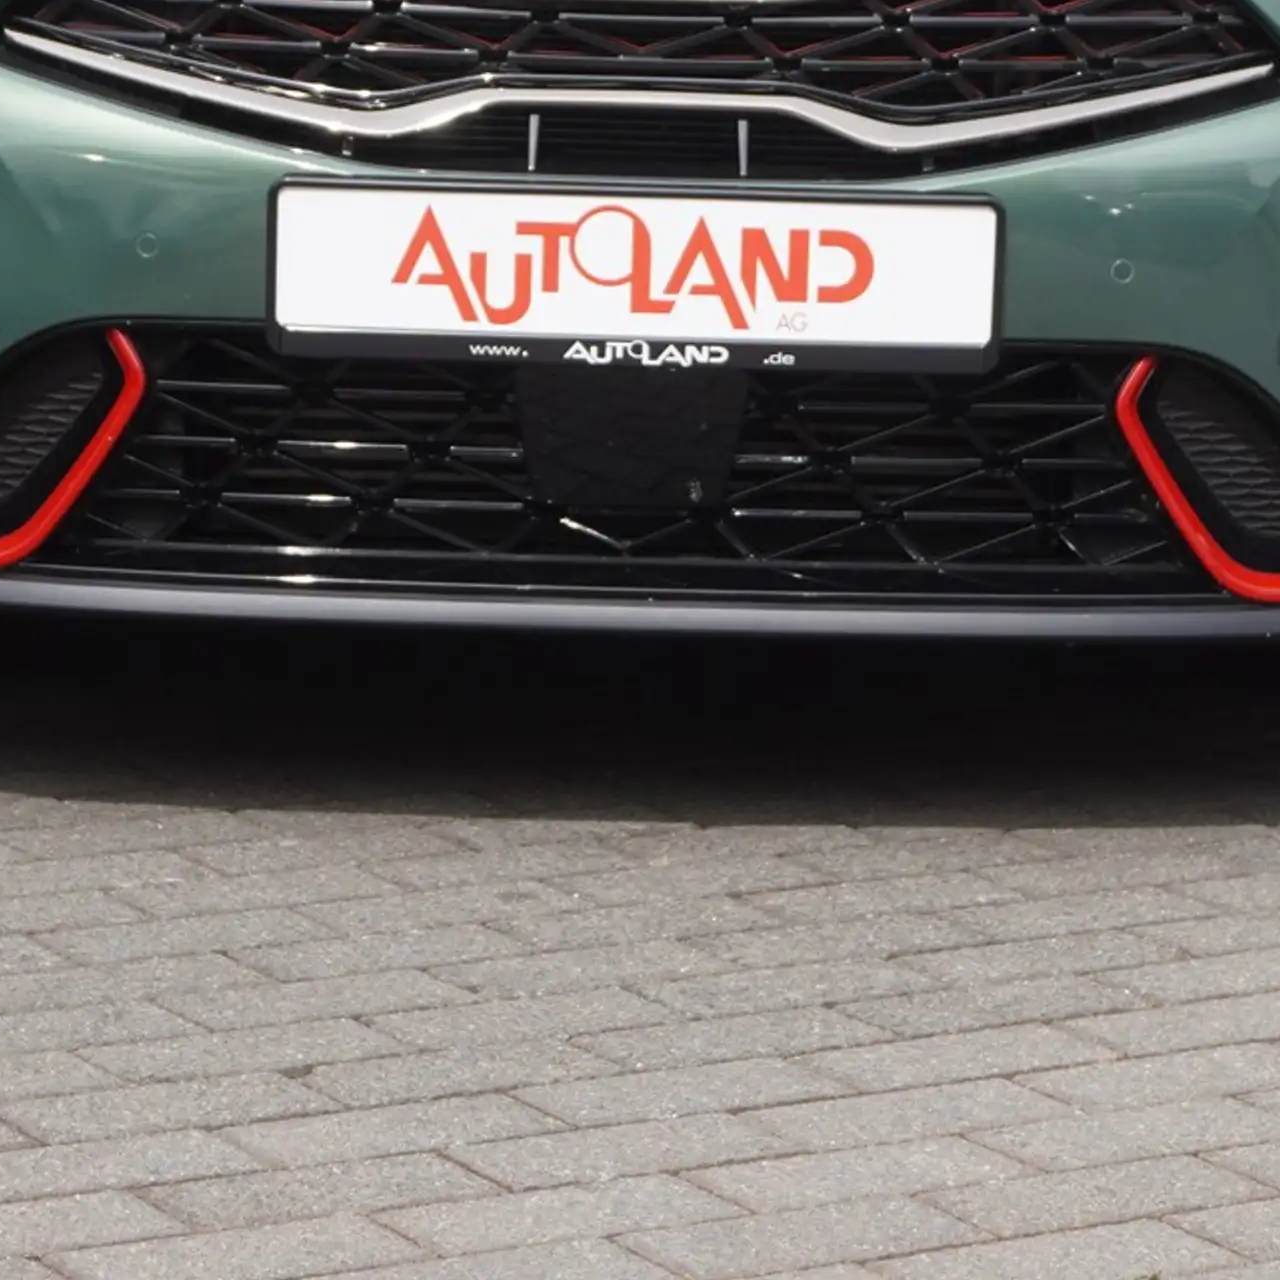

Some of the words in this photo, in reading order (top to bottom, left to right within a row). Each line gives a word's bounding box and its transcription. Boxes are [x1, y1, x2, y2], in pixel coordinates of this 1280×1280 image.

[391, 205, 874, 330] AUTOLAND
[776, 312, 808, 333] AG
[469, 343, 529, 358] www.
[563, 339, 730, 368] AUTOLAND
[763, 351, 796, 367] .de
